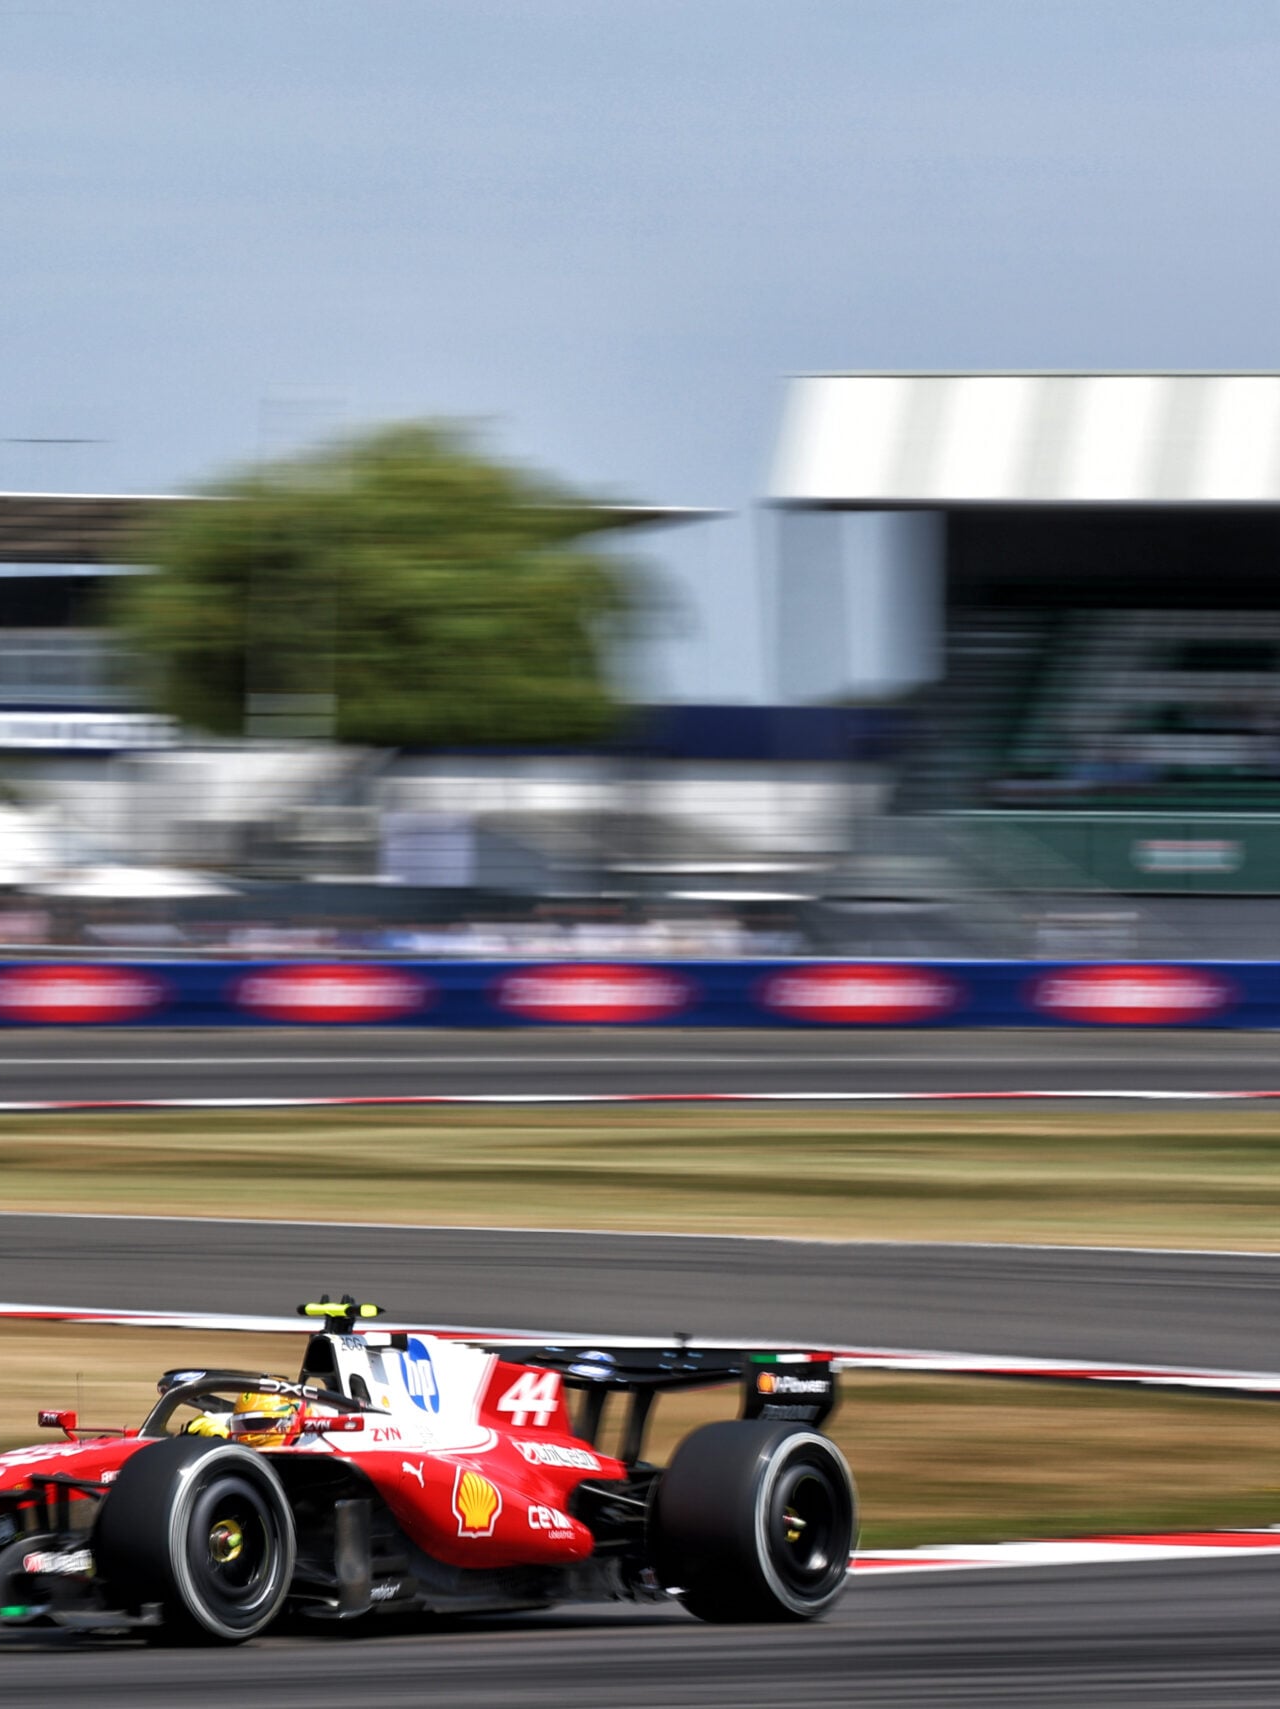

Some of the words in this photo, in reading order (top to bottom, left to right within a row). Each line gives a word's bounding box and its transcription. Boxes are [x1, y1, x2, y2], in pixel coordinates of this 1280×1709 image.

[260, 1377, 318, 1399] DXC
[400, 1345, 439, 1413] hp
[497, 1372, 562, 1426] 44
[304, 1419, 332, 1431] ZYN
[370, 1427, 402, 1442] ZYN
